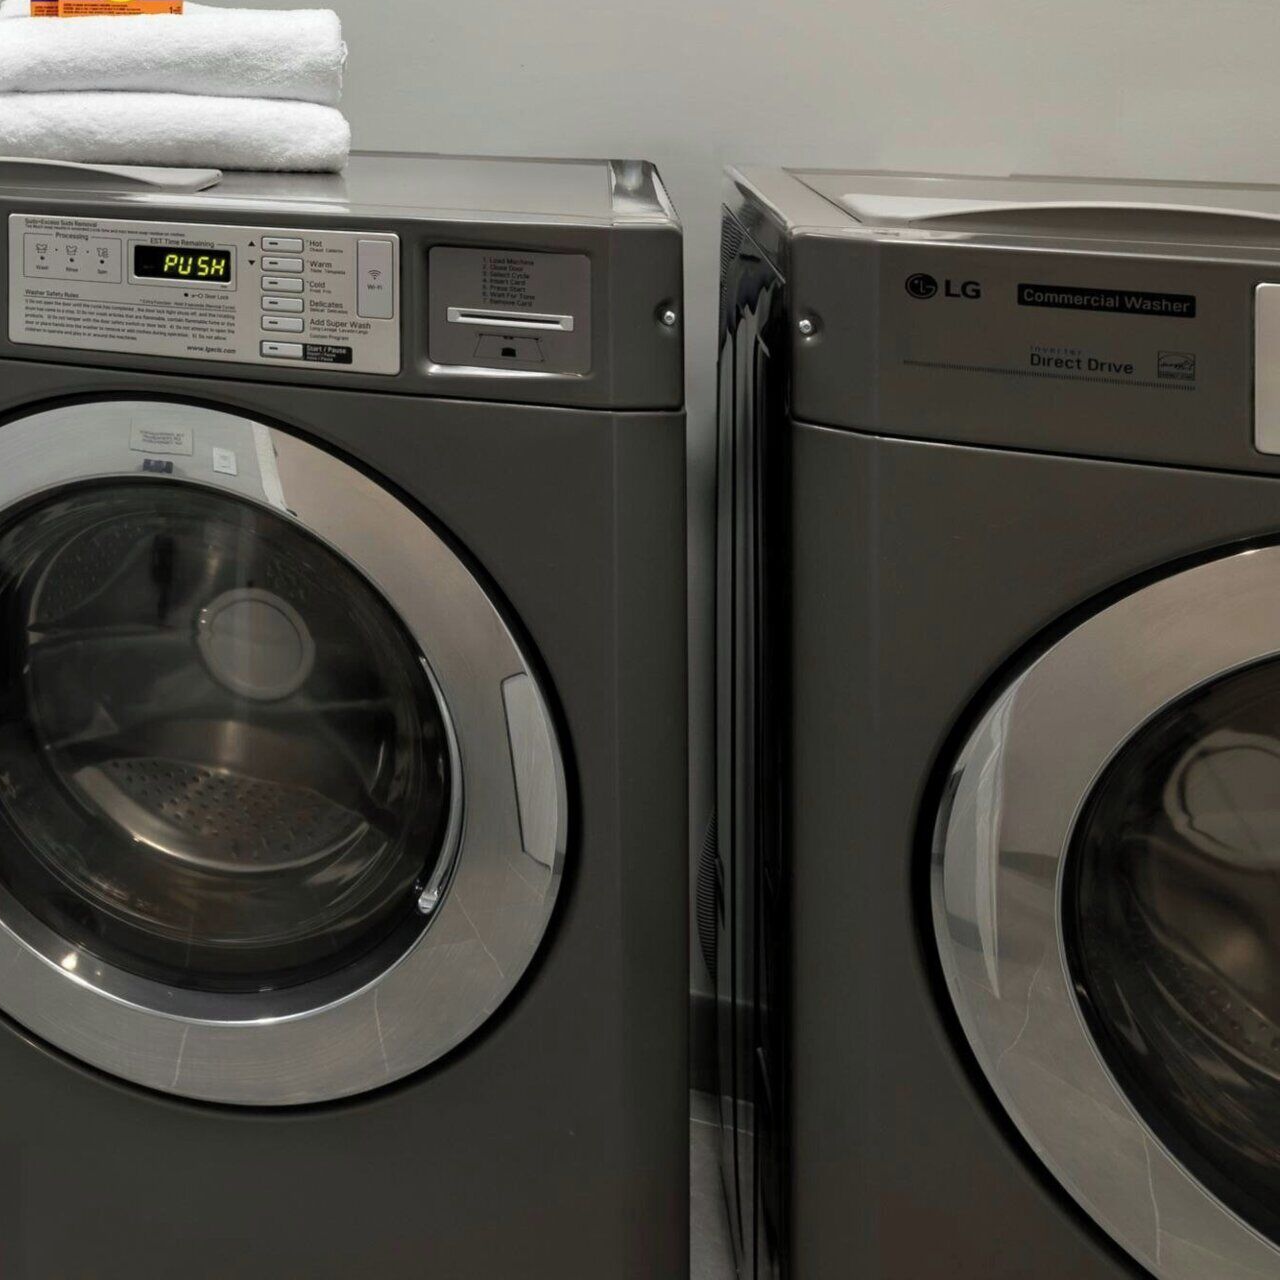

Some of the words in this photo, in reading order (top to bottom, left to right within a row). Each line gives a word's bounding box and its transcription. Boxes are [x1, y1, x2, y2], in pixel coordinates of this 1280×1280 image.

[56, 232, 89, 241] Processing
[181, 240, 215, 248] Remaining
[164, 254, 225, 276] PUSH
[944, 279, 981, 299] LG
[309, 300, 343, 308] Delicates
[1023, 288, 1119, 308] Commercial
[1124, 297, 1190, 313] Washer
[1030, 353, 1082, 369] Direct
[1087, 358, 1135, 374] Drive
